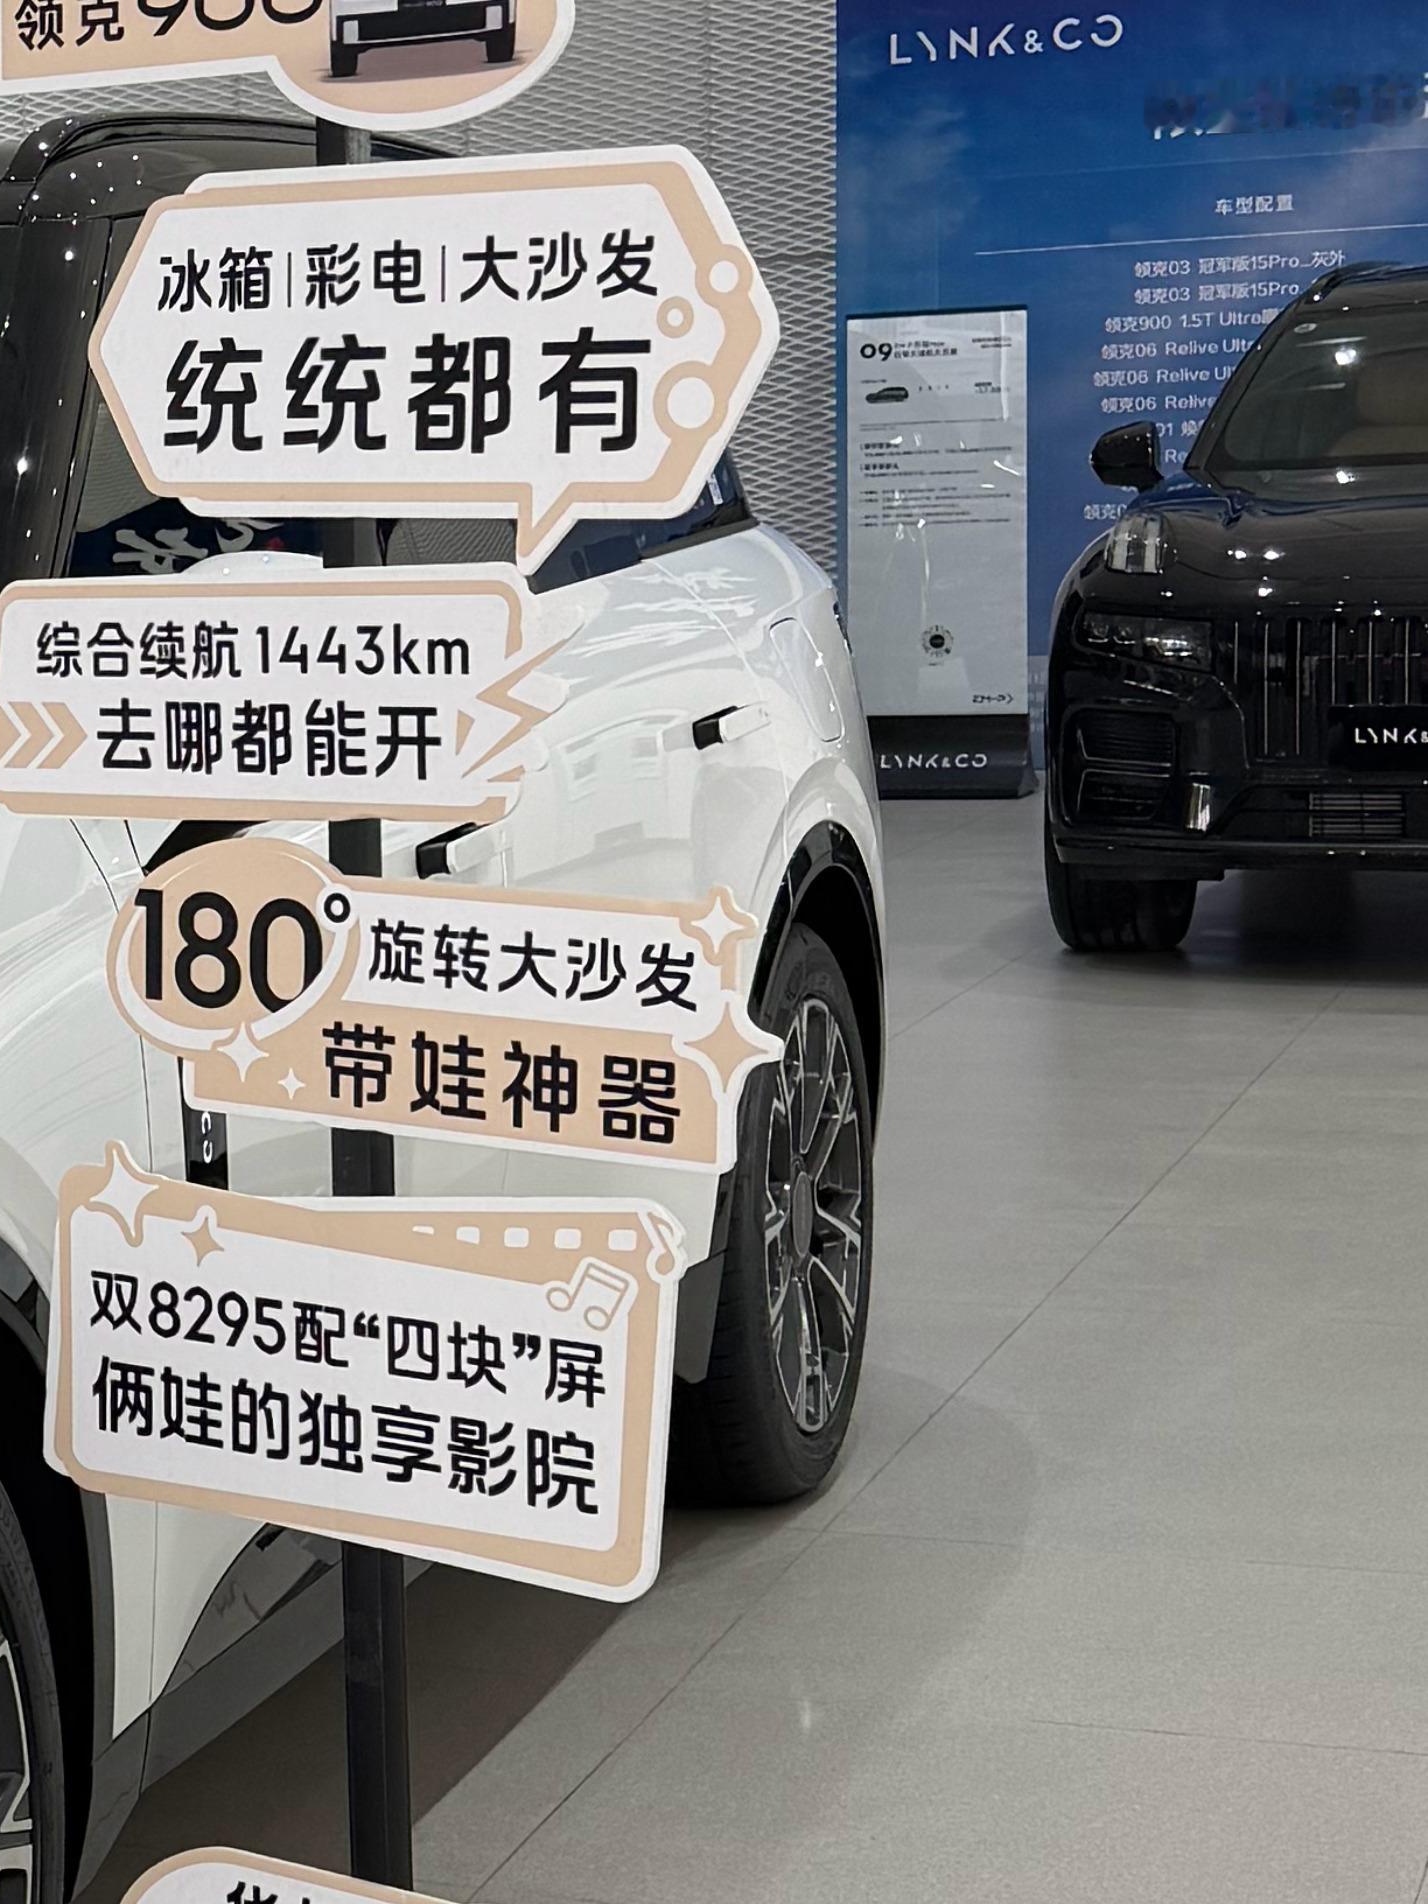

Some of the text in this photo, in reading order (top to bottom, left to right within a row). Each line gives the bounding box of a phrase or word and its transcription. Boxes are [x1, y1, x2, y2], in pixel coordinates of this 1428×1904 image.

[1215, 194, 1294, 216] 车型配置
[163, 326, 654, 455] 统统都有
[1157, 367, 1211, 384] Relive
[1165, 339, 1219, 356] Relive
[95, 696, 444, 781] 去哪都能开
[368, 917, 703, 1014] 旋转大沙发
[321, 1020, 682, 1145] 带娃神器
[91, 1354, 600, 1516] 俩娃的独享影院
